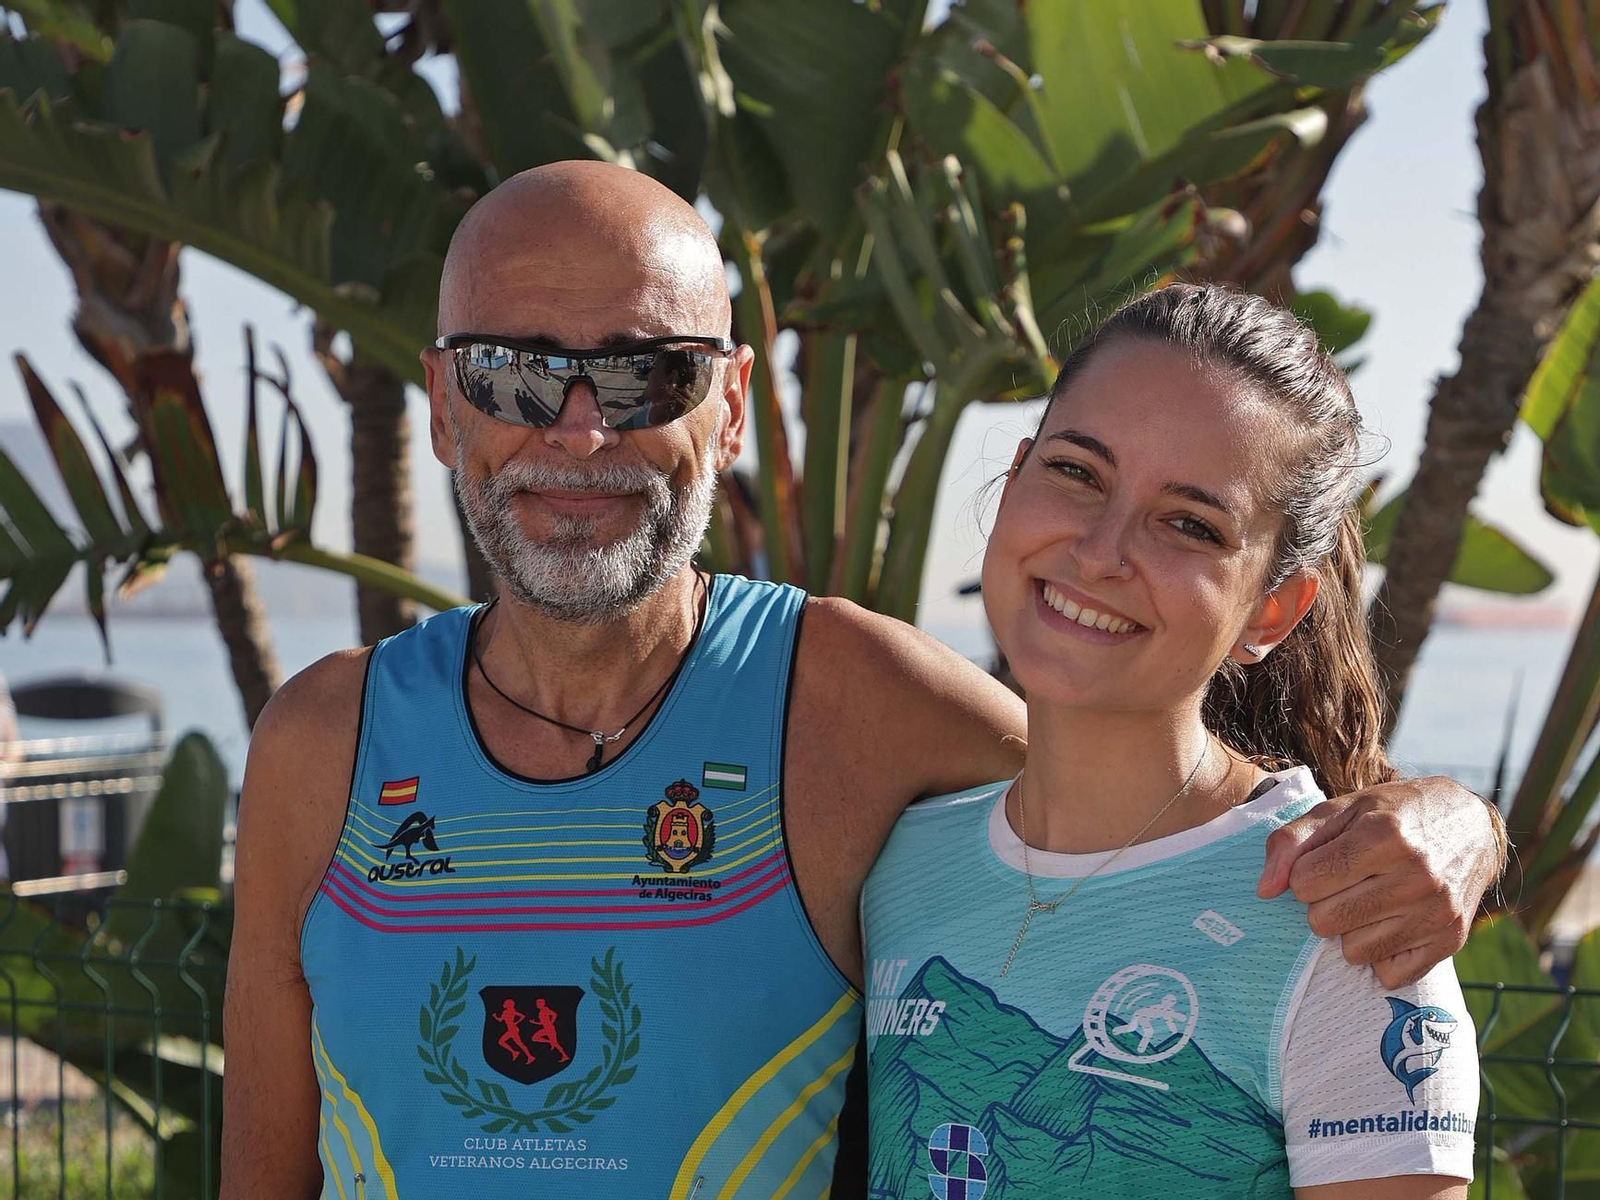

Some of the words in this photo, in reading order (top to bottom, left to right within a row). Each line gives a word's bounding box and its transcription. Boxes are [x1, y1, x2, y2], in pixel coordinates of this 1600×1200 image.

[367, 857, 456, 883] austral
[632, 875, 721, 889] Ayuntamiento
[639, 889, 653, 899] de
[655, 888, 713, 902] Algeciras
[870, 959, 909, 997] MAT
[464, 1137, 507, 1150] CLUB
[512, 1138, 587, 1151] ATLETAS
[429, 1155, 525, 1169] VETERANOS
[529, 1157, 629, 1171] ALGECIRAS
